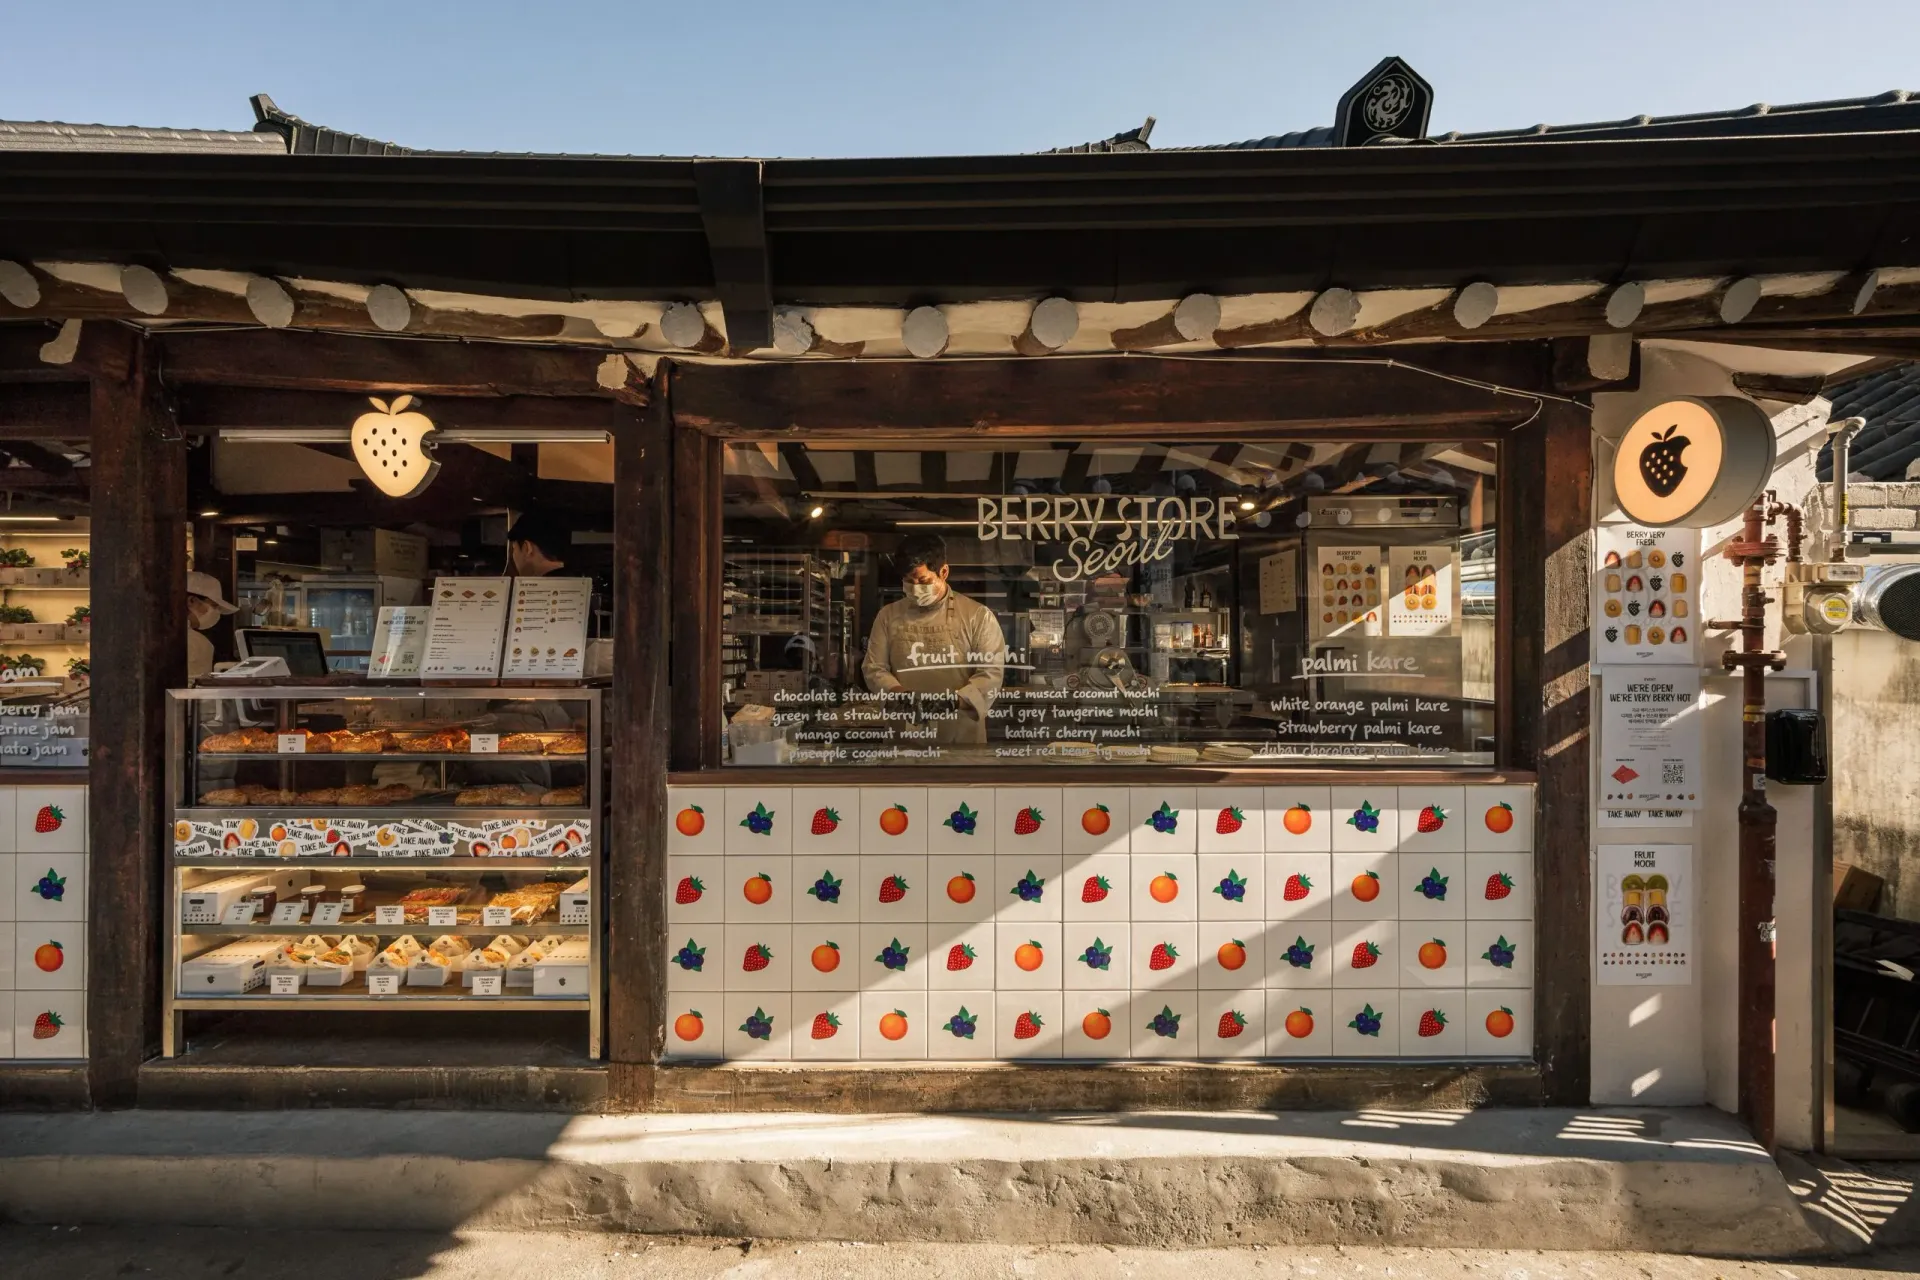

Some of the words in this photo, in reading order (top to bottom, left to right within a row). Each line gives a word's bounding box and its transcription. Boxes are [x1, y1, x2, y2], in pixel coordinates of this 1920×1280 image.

[978, 497, 1104, 541] BERRY
[1117, 497, 1239, 541] STORE
[1627, 530, 1648, 538] BERRY
[1648, 530, 1666, 538] VERY
[1052, 516, 1175, 582] Seoul
[907, 642, 959, 666] fruit
[1301, 650, 1358, 679] palmi
[1367, 651, 1419, 672] kare
[987, 687, 1020, 699] shine
[1025, 687, 1069, 700] muscat
[1072, 688, 1119, 699] coconut
[1124, 687, 1160, 699] mochi
[1627, 684, 1650, 692] WE'RE
[1651, 684, 1674, 692] OPEN!
[774, 688, 837, 702] chocolate
[842, 688, 915, 705] strawberry
[920, 689, 959, 702] mochi
[1610, 694, 1632, 702] WE'RE
[1634, 694, 1651, 702] VERY
[1652, 694, 1676, 702] BERRY
[1676, 694, 1692, 702] HOT
[46, 703, 80, 720] jam
[988, 706, 1014, 718] earl
[1018, 708, 1046, 723] grey
[1052, 705, 1114, 722] tangerine
[1119, 705, 1158, 718] mochi
[1271, 696, 1310, 712] white
[1315, 699, 1365, 716] orange
[1371, 697, 1409, 716] palmi
[1415, 698, 1450, 712] kare
[772, 710, 810, 726] green
[815, 710, 838, 721] tea
[843, 709, 916, 725] strawberry
[920, 709, 958, 721] mochi
[42, 722, 75, 740] jam
[795, 730, 840, 745] mango
[845, 728, 896, 740] coconut
[900, 728, 938, 740] mochi
[1004, 725, 1050, 740] kataifi
[1056, 726, 1097, 742] cherry
[1102, 725, 1140, 738] mochi
[1364, 720, 1402, 740] palmi
[1408, 721, 1442, 735] kare
[32, 742, 68, 760] jam
[789, 746, 847, 764] pineapple
[852, 746, 899, 759] coconut
[904, 746, 942, 759] mochi
[995, 744, 1032, 758] sweet
[1036, 745, 1056, 757] red
[1062, 744, 1090, 756] bean
[1096, 743, 1112, 760] fig
[1260, 742, 1297, 756] dubai
[1302, 742, 1366, 756] chocolate
[1374, 742, 1410, 761] palmi
[1648, 810, 1664, 818] TAKE
[1665, 810, 1683, 818] AWAY
[330, 820, 346, 828] TAKE
[346, 820, 366, 829] AWAY
[392, 825, 406, 835] TAKE
[450, 826, 468, 838] TAKE
[484, 822, 500, 832] TAKE
[288, 828, 303, 838] TAKE
[347, 834, 360, 842] TAKE
[362, 830, 376, 838] AWAY
[401, 836, 416, 844] TAKE
[535, 834, 548, 844] TAKE
[548, 828, 562, 838] AWAY
[188, 844, 205, 855] AWAY
[300, 842, 318, 852] TAKE
[414, 849, 431, 858] TAKE
[432, 847, 450, 855] AWAY
[1634, 850, 1655, 858] FRUIT
